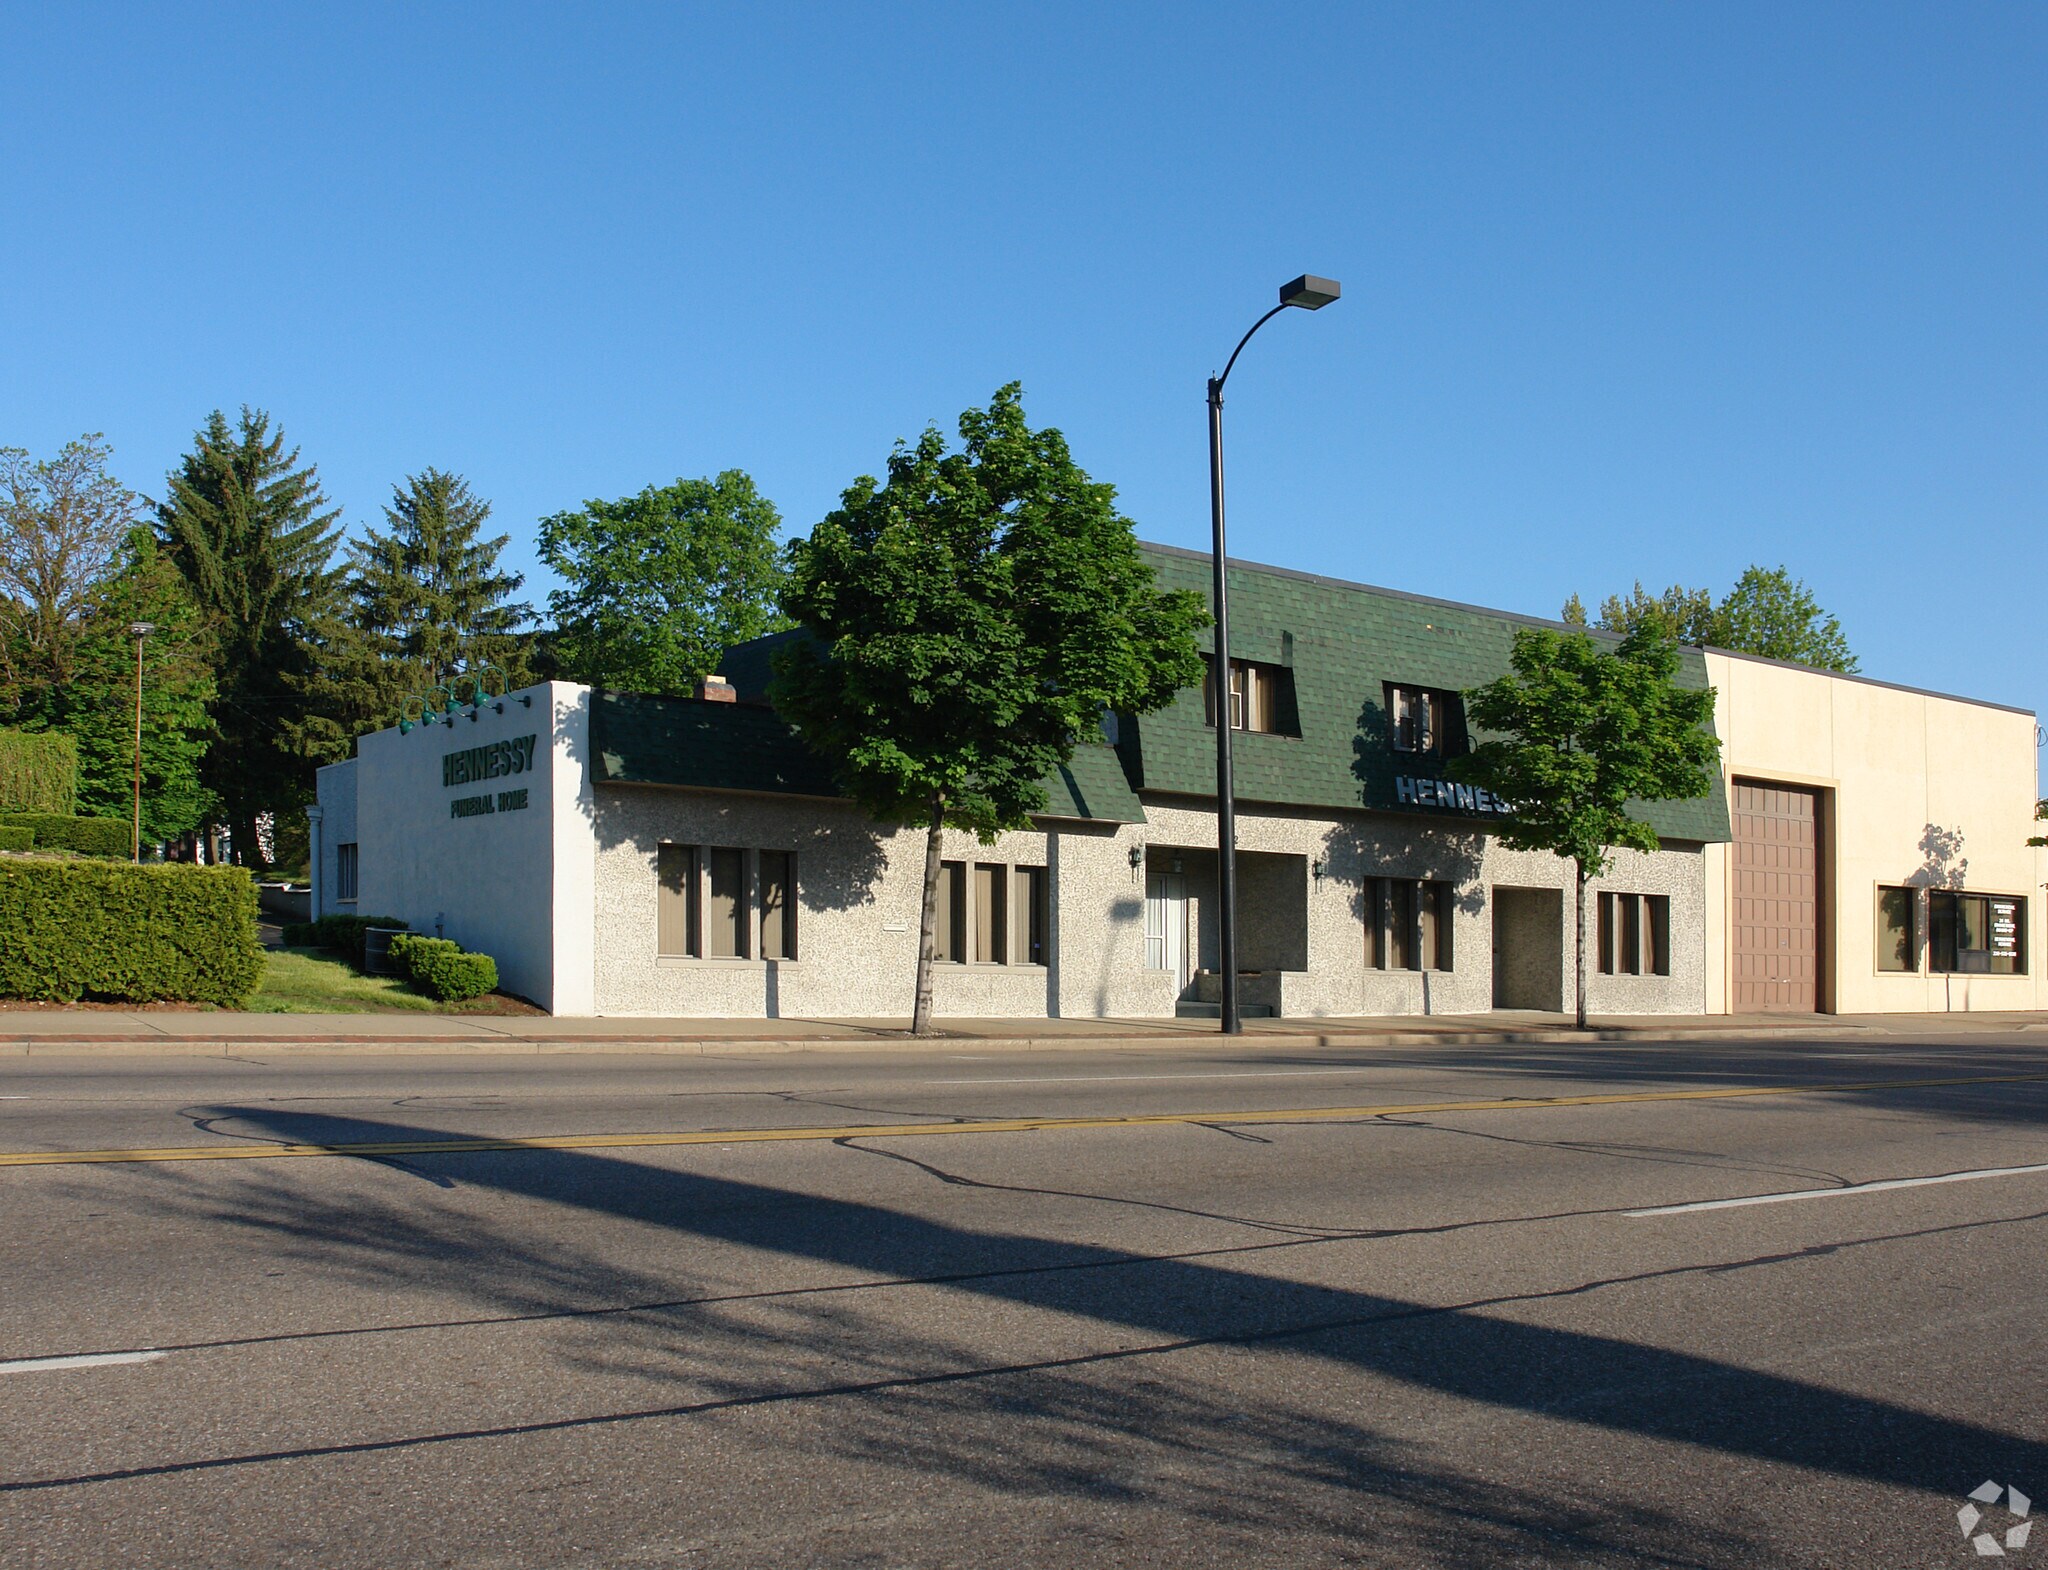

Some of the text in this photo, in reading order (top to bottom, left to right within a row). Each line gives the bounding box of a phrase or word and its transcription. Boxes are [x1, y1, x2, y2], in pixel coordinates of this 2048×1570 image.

[442, 733, 537, 787] HENNESSY
[450, 788, 529, 819] FUNERAL HOME
[1395, 776, 1517, 814] HENNES
